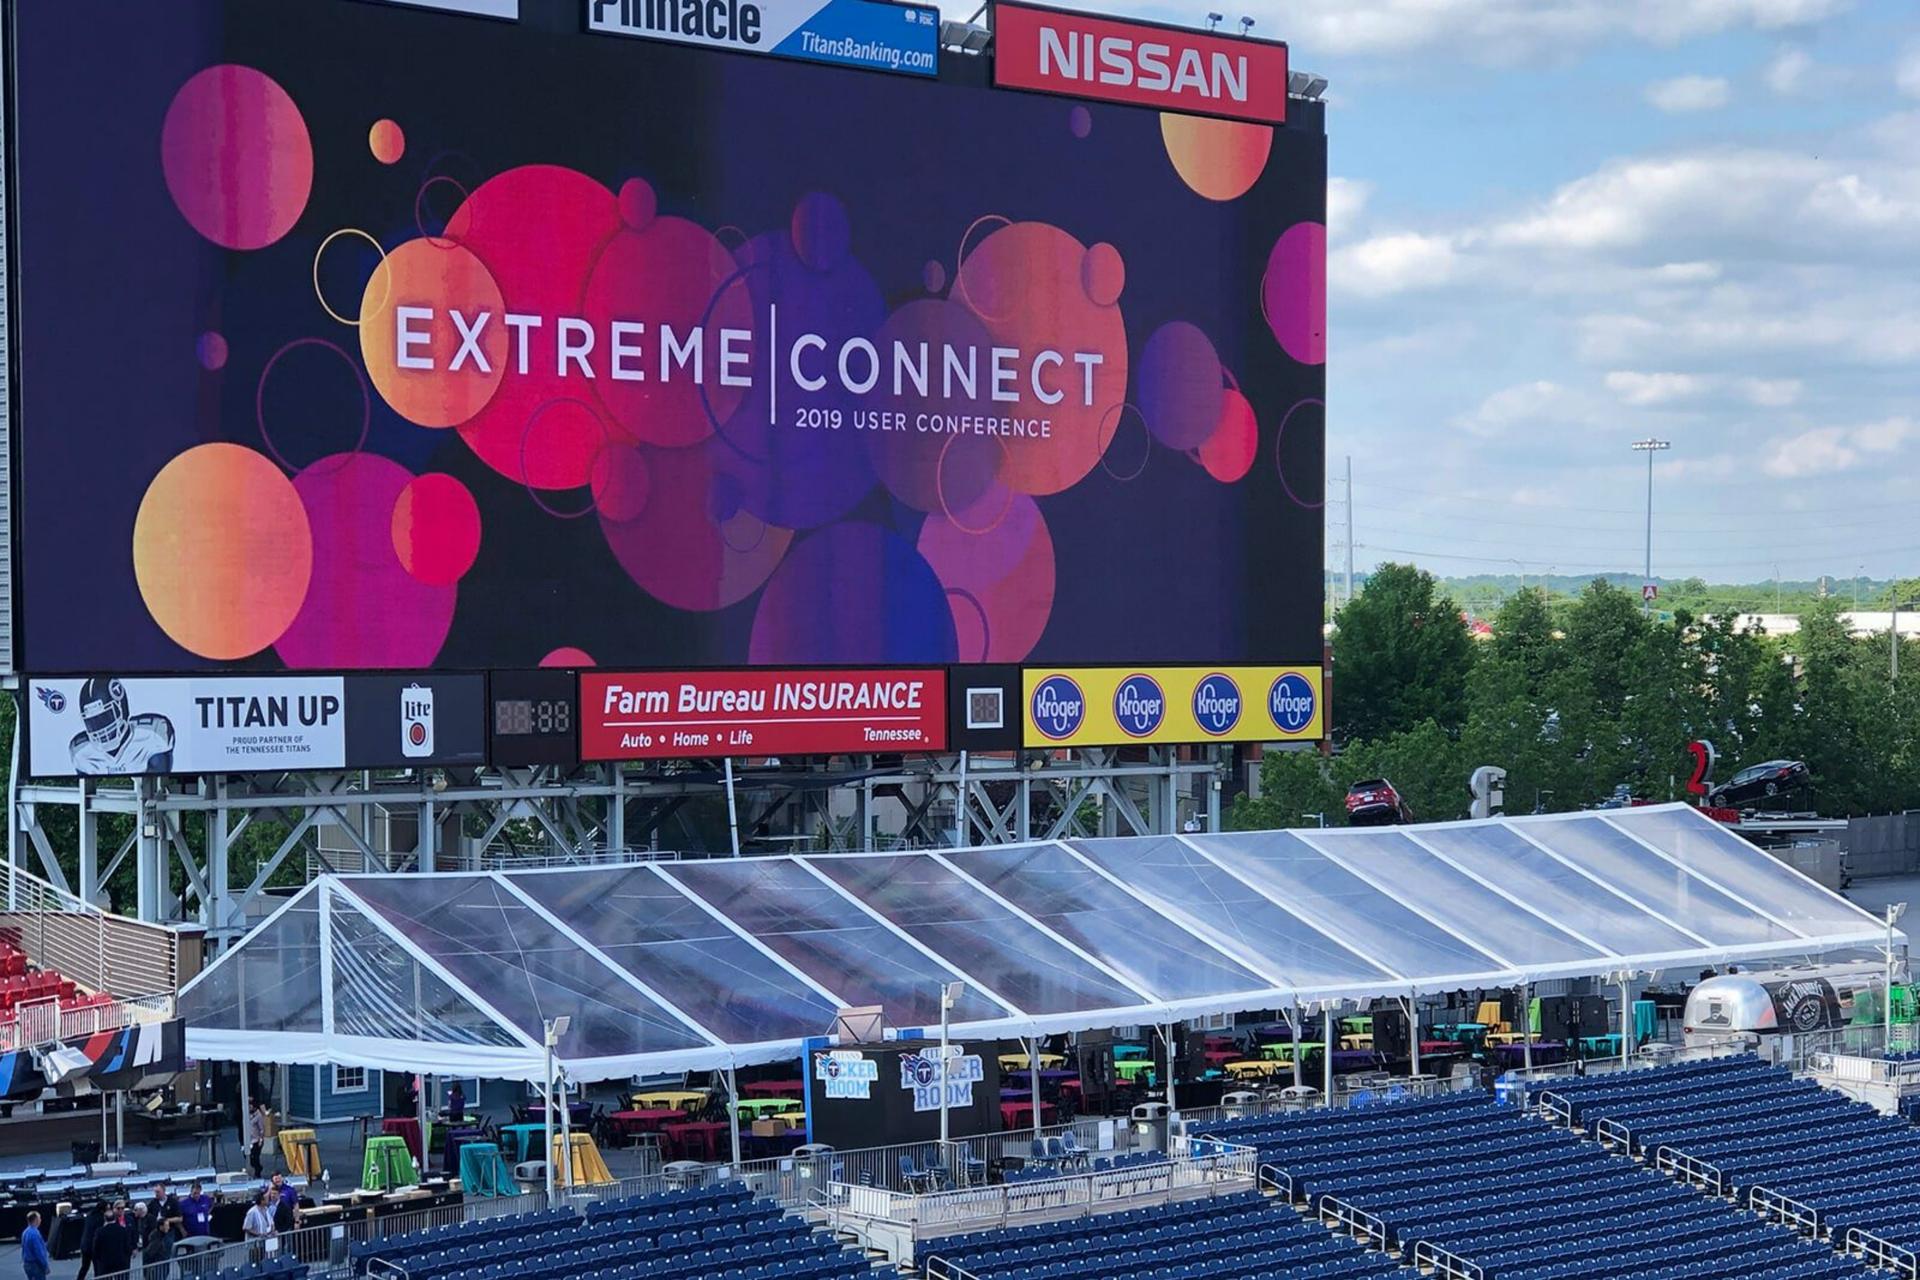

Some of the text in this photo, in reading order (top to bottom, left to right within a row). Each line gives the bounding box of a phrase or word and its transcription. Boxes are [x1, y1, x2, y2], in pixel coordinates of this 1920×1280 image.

[802, 31, 934, 69] TitansBanking.com
[1040, 27, 1247, 102] NISSAN
[396, 306, 1104, 406] EXTREME CONNECT
[796, 408, 1051, 437] 2019 USER CONFERENCE
[1644, 587, 1656, 599] A
[195, 695, 339, 728] TITAN UP
[404, 701, 430, 720] Lite
[604, 682, 923, 714] Farm Bureau INSURANCE
[1037, 686, 1081, 731] Kroger
[1119, 684, 1161, 729] Kroger
[1198, 683, 1238, 727] Kroger
[1273, 682, 1312, 726] Kroger
[226, 744, 312, 754] THE TENNESSEE TITANS
[232, 735, 304, 744] PROUD PARTNER OF
[620, 730, 753, 748] Auto Home Life
[863, 727, 922, 742] Tennessee
[1686, 741, 1707, 795] 2
[818, 1060, 877, 1078] LCKER
[828, 1080, 869, 1097] ROOM
